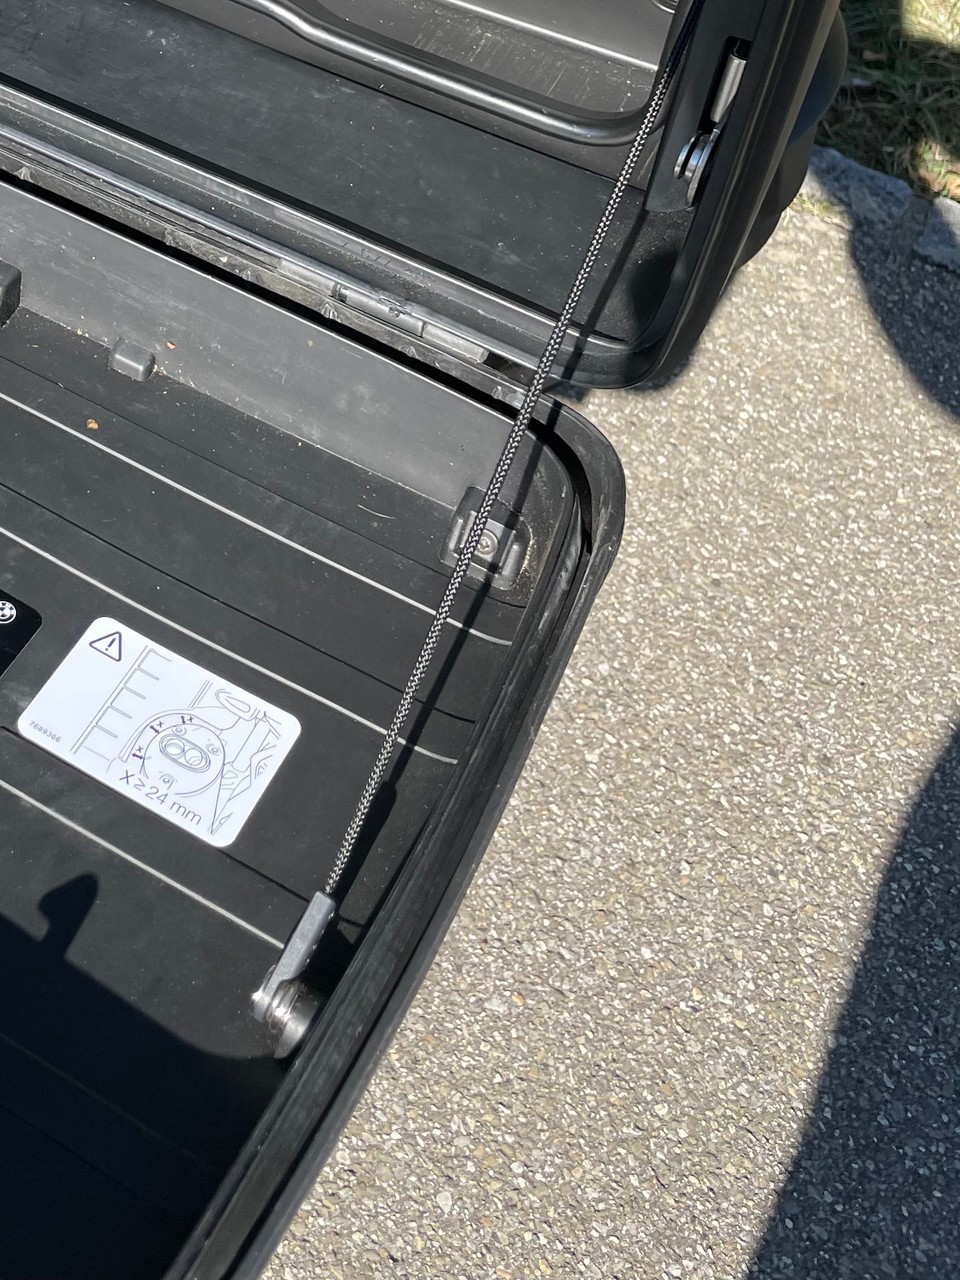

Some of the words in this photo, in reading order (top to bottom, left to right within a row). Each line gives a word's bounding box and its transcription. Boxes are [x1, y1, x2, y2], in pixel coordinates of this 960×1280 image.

[29, 720, 61, 743] 7689366
[119, 770, 135, 785] X
[145, 786, 168, 805] 24
[170, 801, 202, 826] mm
